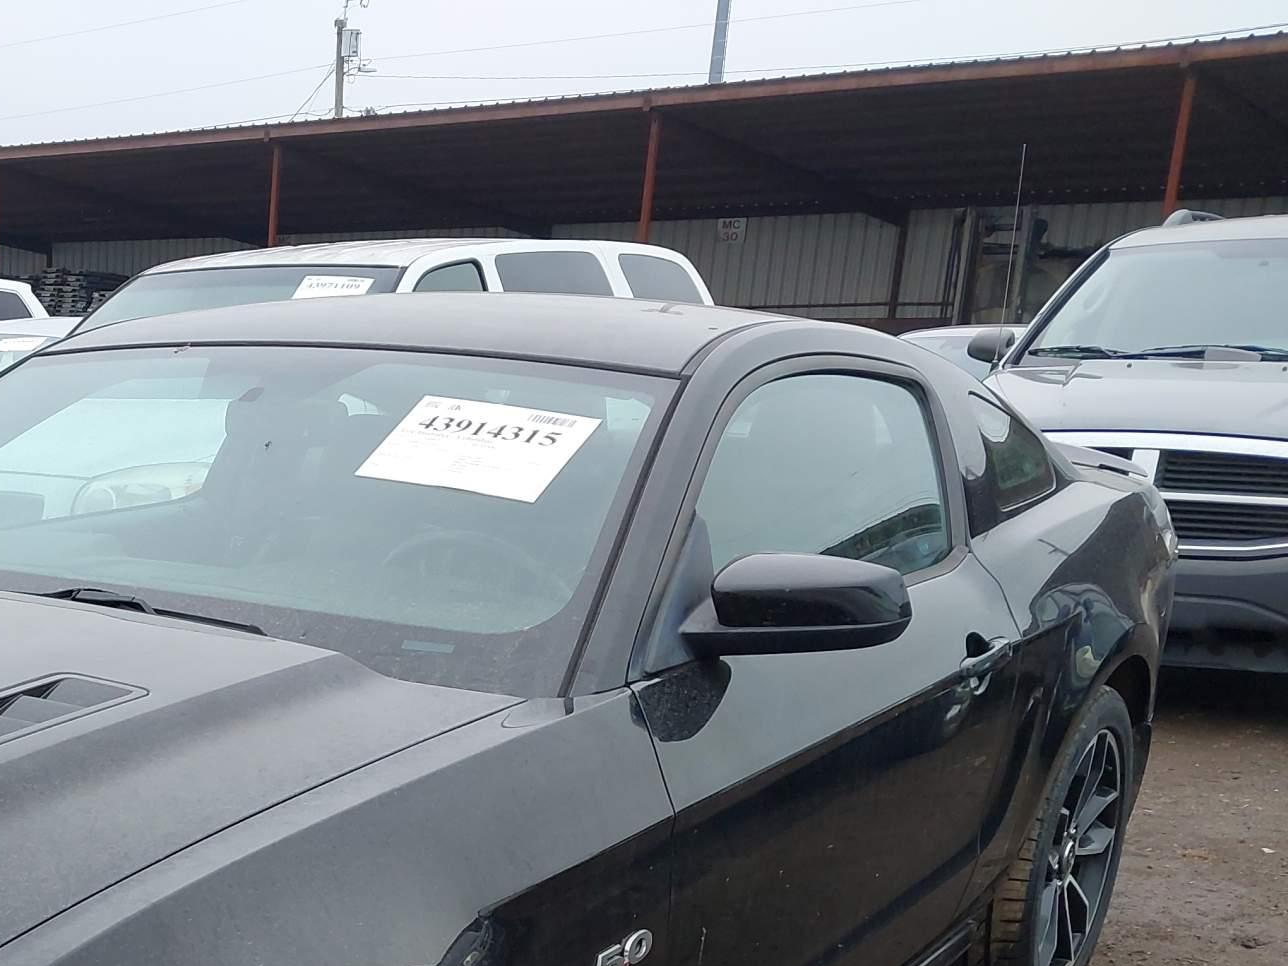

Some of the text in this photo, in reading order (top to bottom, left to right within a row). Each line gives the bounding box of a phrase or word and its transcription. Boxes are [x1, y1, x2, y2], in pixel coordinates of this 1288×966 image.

[722, 219, 741, 229] MC
[722, 231, 739, 241] 30
[418, 415, 563, 447] 43914315
